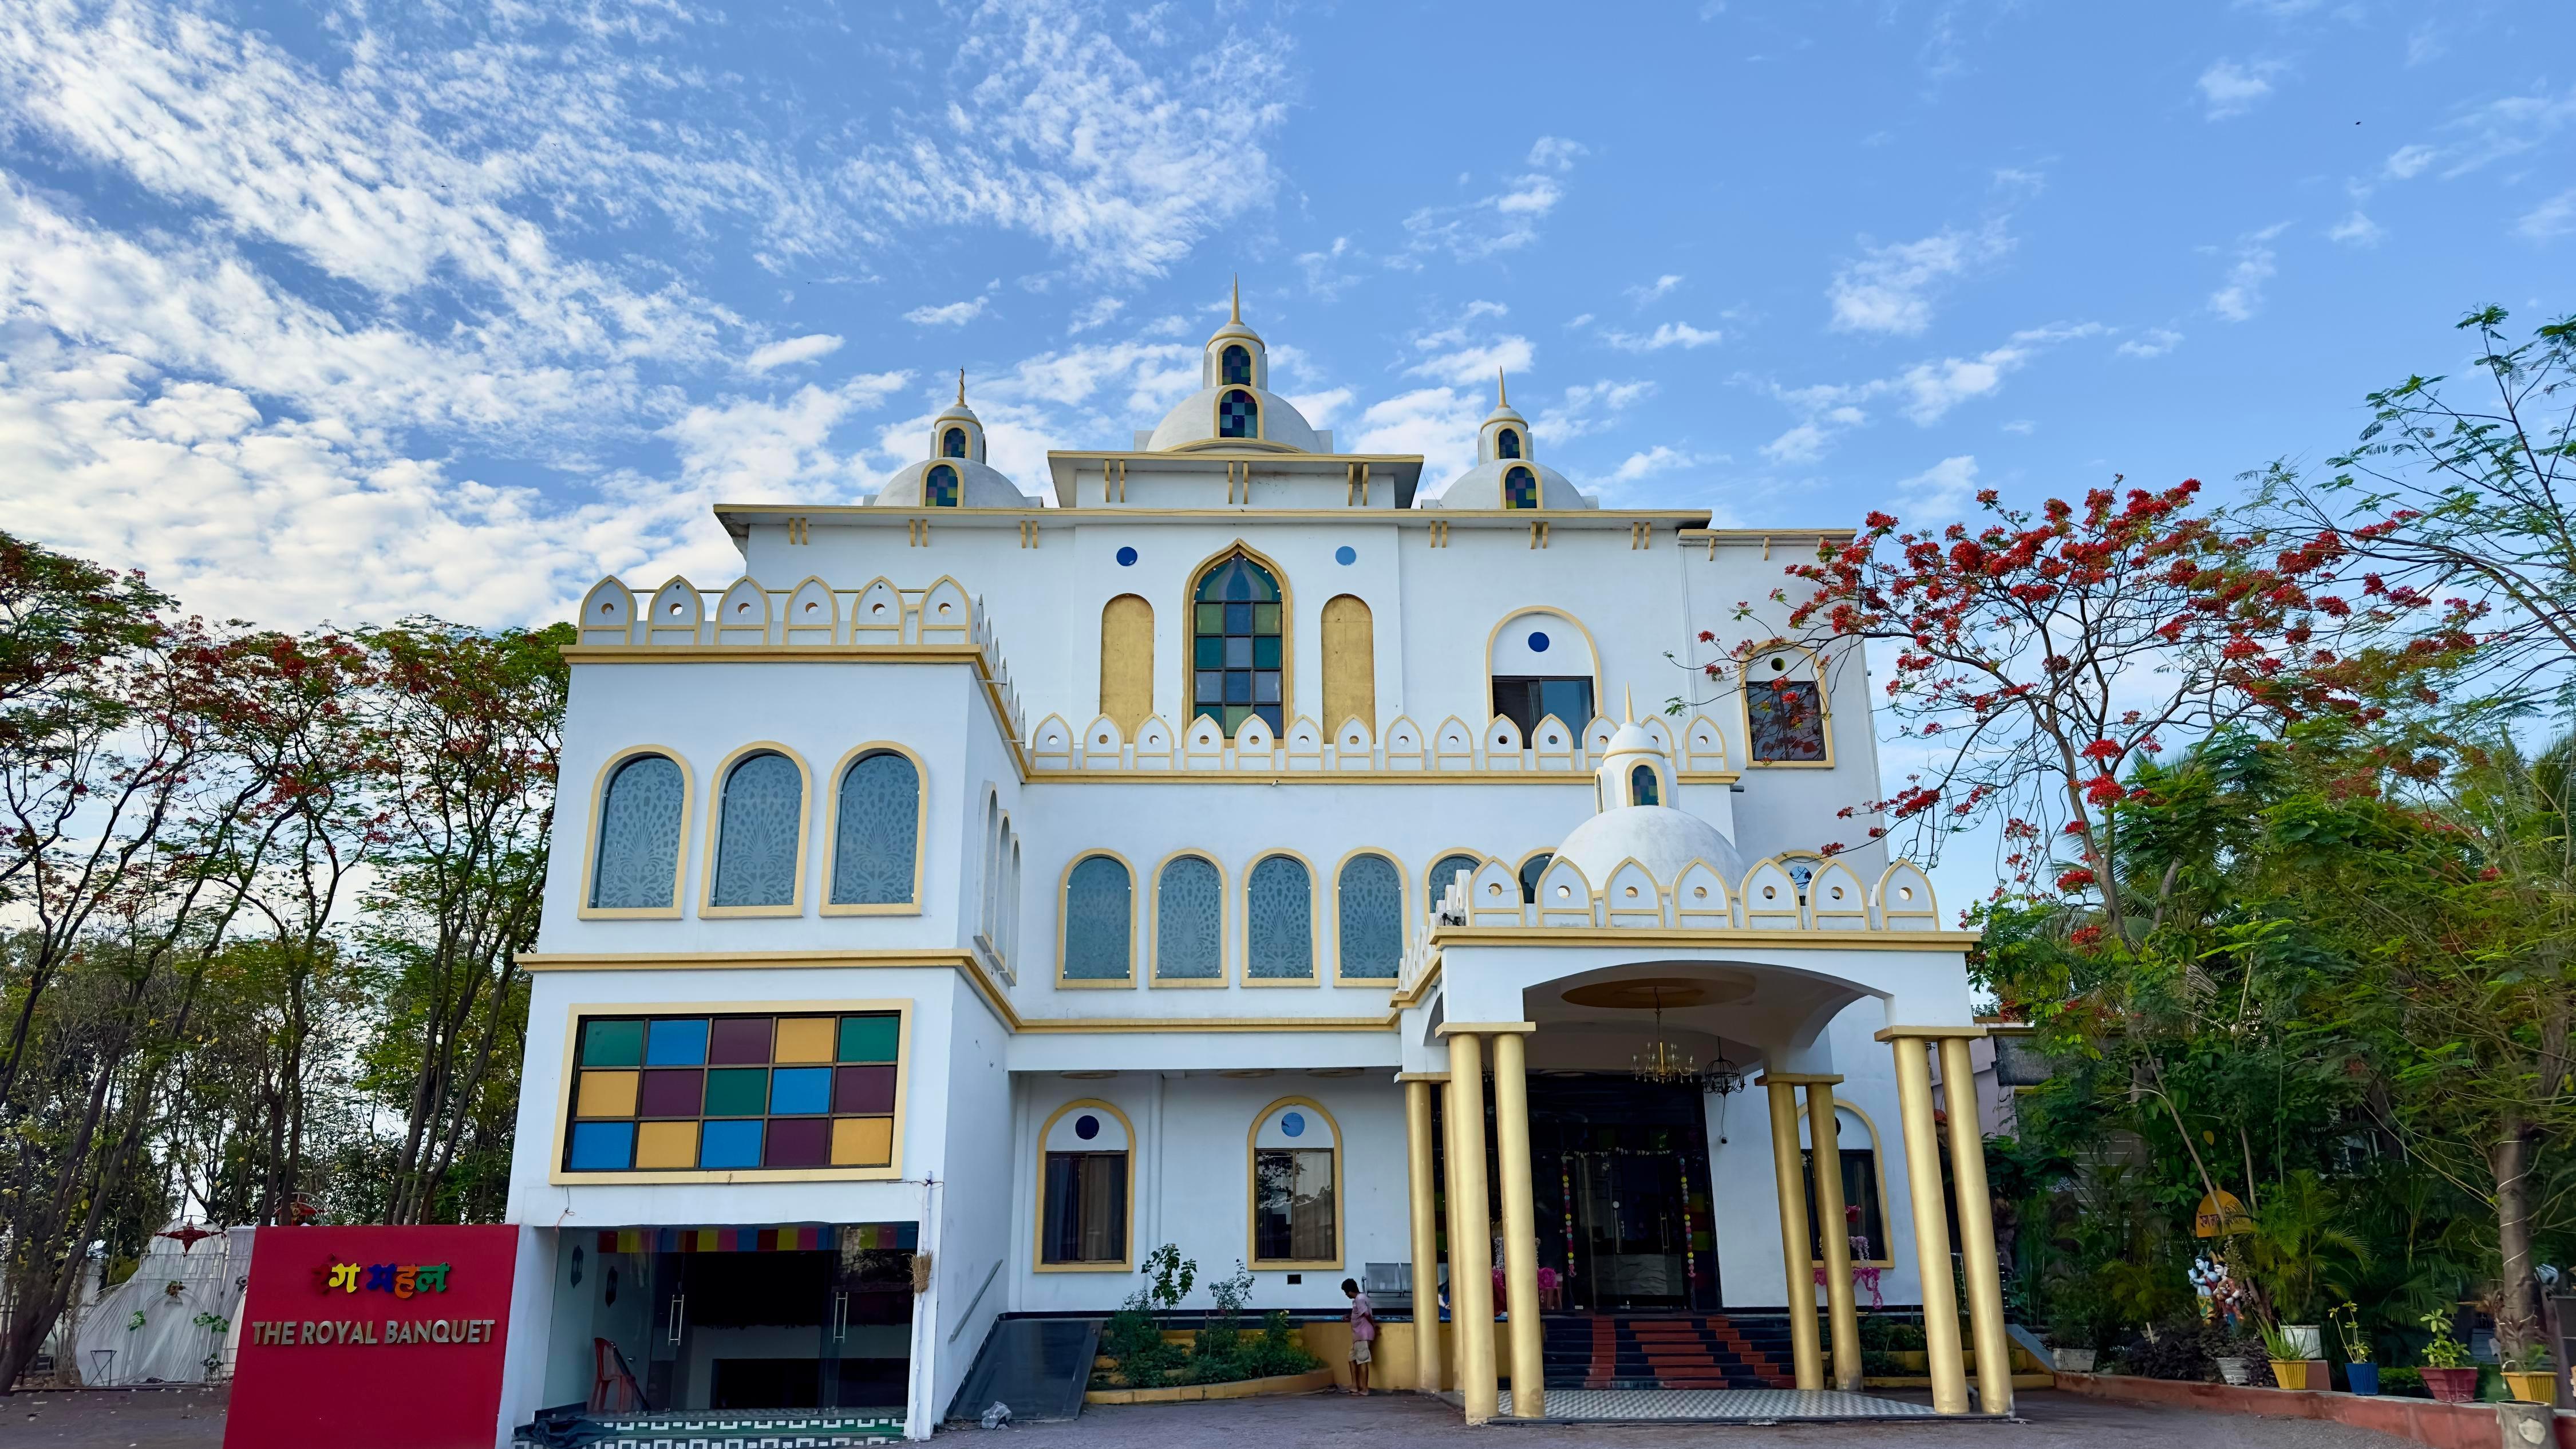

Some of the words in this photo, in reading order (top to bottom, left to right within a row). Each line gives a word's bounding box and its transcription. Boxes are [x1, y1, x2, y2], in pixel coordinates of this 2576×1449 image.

[366, 1262, 451, 1298] महल
[252, 1321, 297, 1345] THE
[301, 1320, 378, 1345] ROYAL
[384, 1319, 495, 1344] BANQUET
